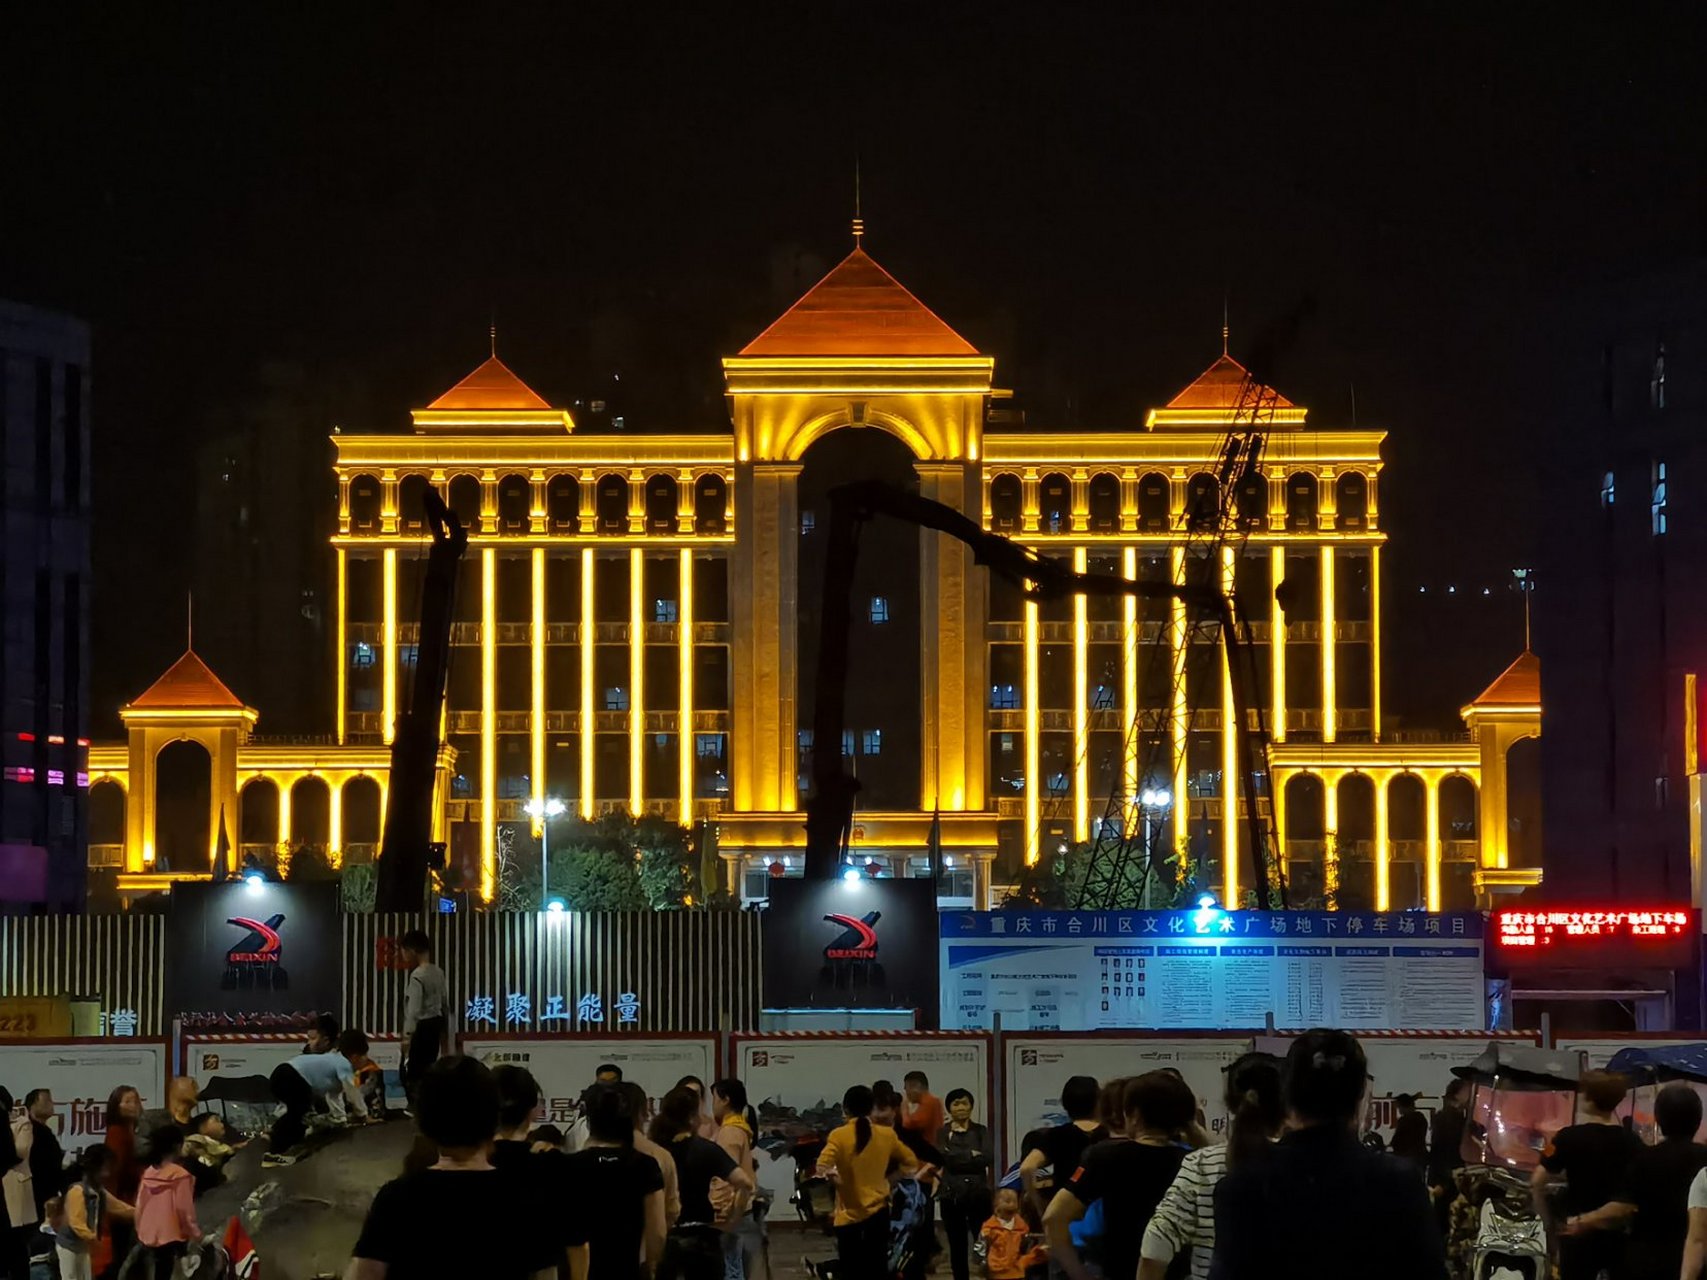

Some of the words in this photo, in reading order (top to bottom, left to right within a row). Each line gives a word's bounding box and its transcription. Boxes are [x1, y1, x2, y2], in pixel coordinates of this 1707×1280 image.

[990, 916, 1465, 934] 重庆市合川区文化艺术广场地下停车场项目
[230, 952, 279, 962] BEIXIN
[465, 992, 641, 1024] 凝聚正能量
